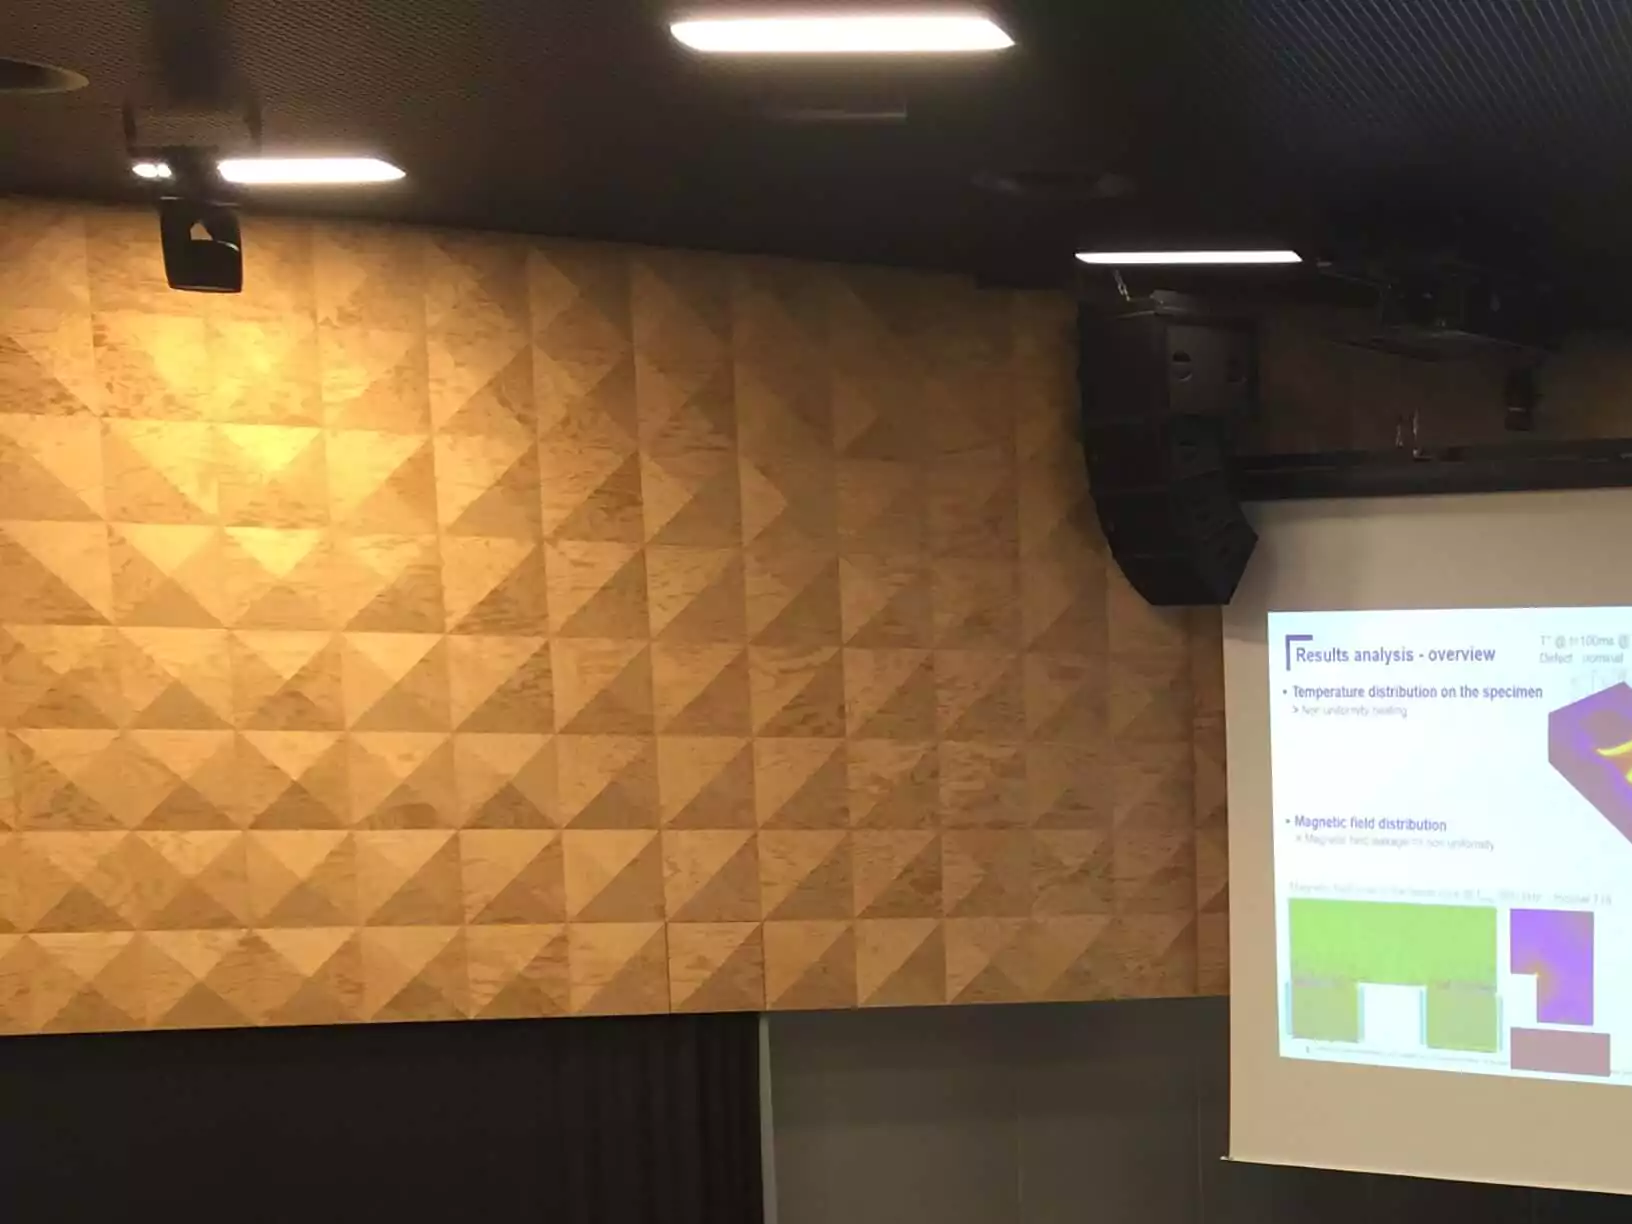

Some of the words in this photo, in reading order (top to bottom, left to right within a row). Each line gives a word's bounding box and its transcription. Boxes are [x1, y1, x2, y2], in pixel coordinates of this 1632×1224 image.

[1296, 646, 1350, 662] Results
[1354, 646, 1415, 665] analysis
[1428, 646, 1496, 662] overview
[1292, 684, 1365, 700] Temperature
[1368, 684, 1438, 699] distribution
[1441, 687, 1457, 698] on
[1460, 684, 1479, 698] the
[1483, 684, 1544, 701] specimen
[1294, 815, 1347, 831] Magnetic
[1350, 815, 1375, 829] field
[1378, 816, 1447, 832] distribution
